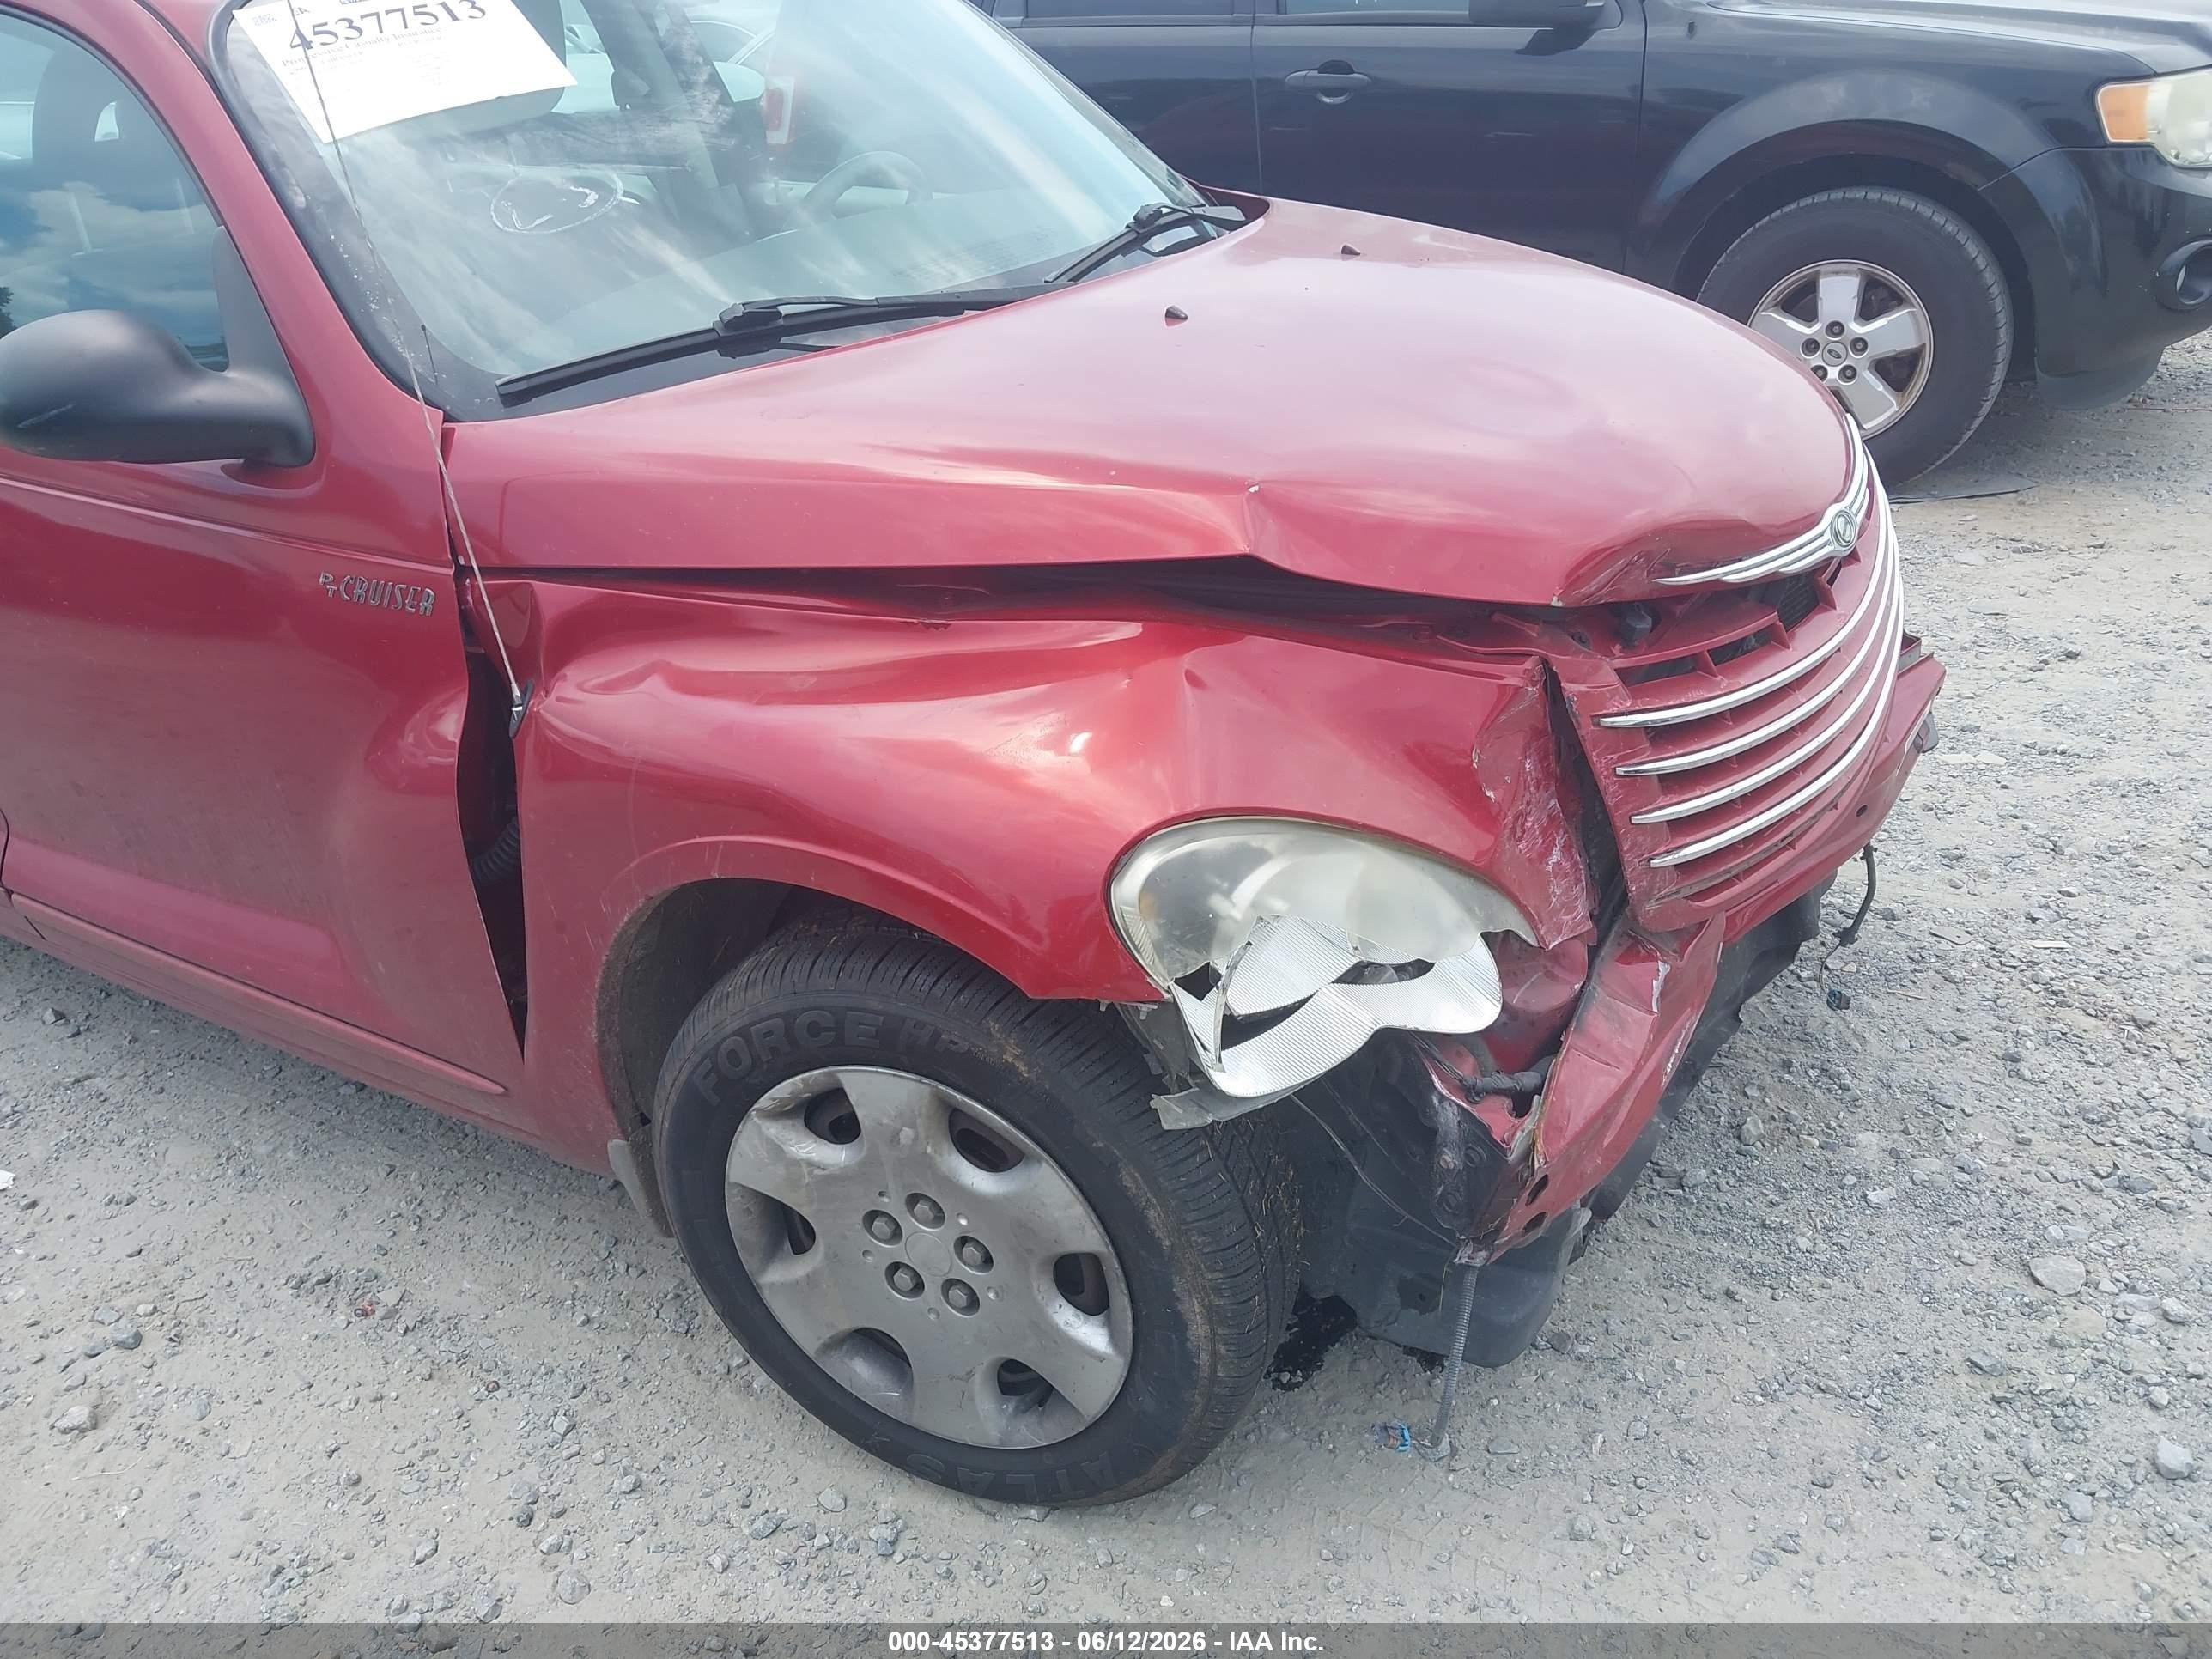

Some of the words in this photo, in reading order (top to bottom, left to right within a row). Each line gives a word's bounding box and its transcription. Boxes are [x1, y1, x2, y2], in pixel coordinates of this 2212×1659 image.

[289, 0, 487, 52] 45377513
[339, 574, 436, 616] CRUISER
[690, 1009, 884, 1107] FORCE
[906, 1451, 1116, 1503] ATLAS
